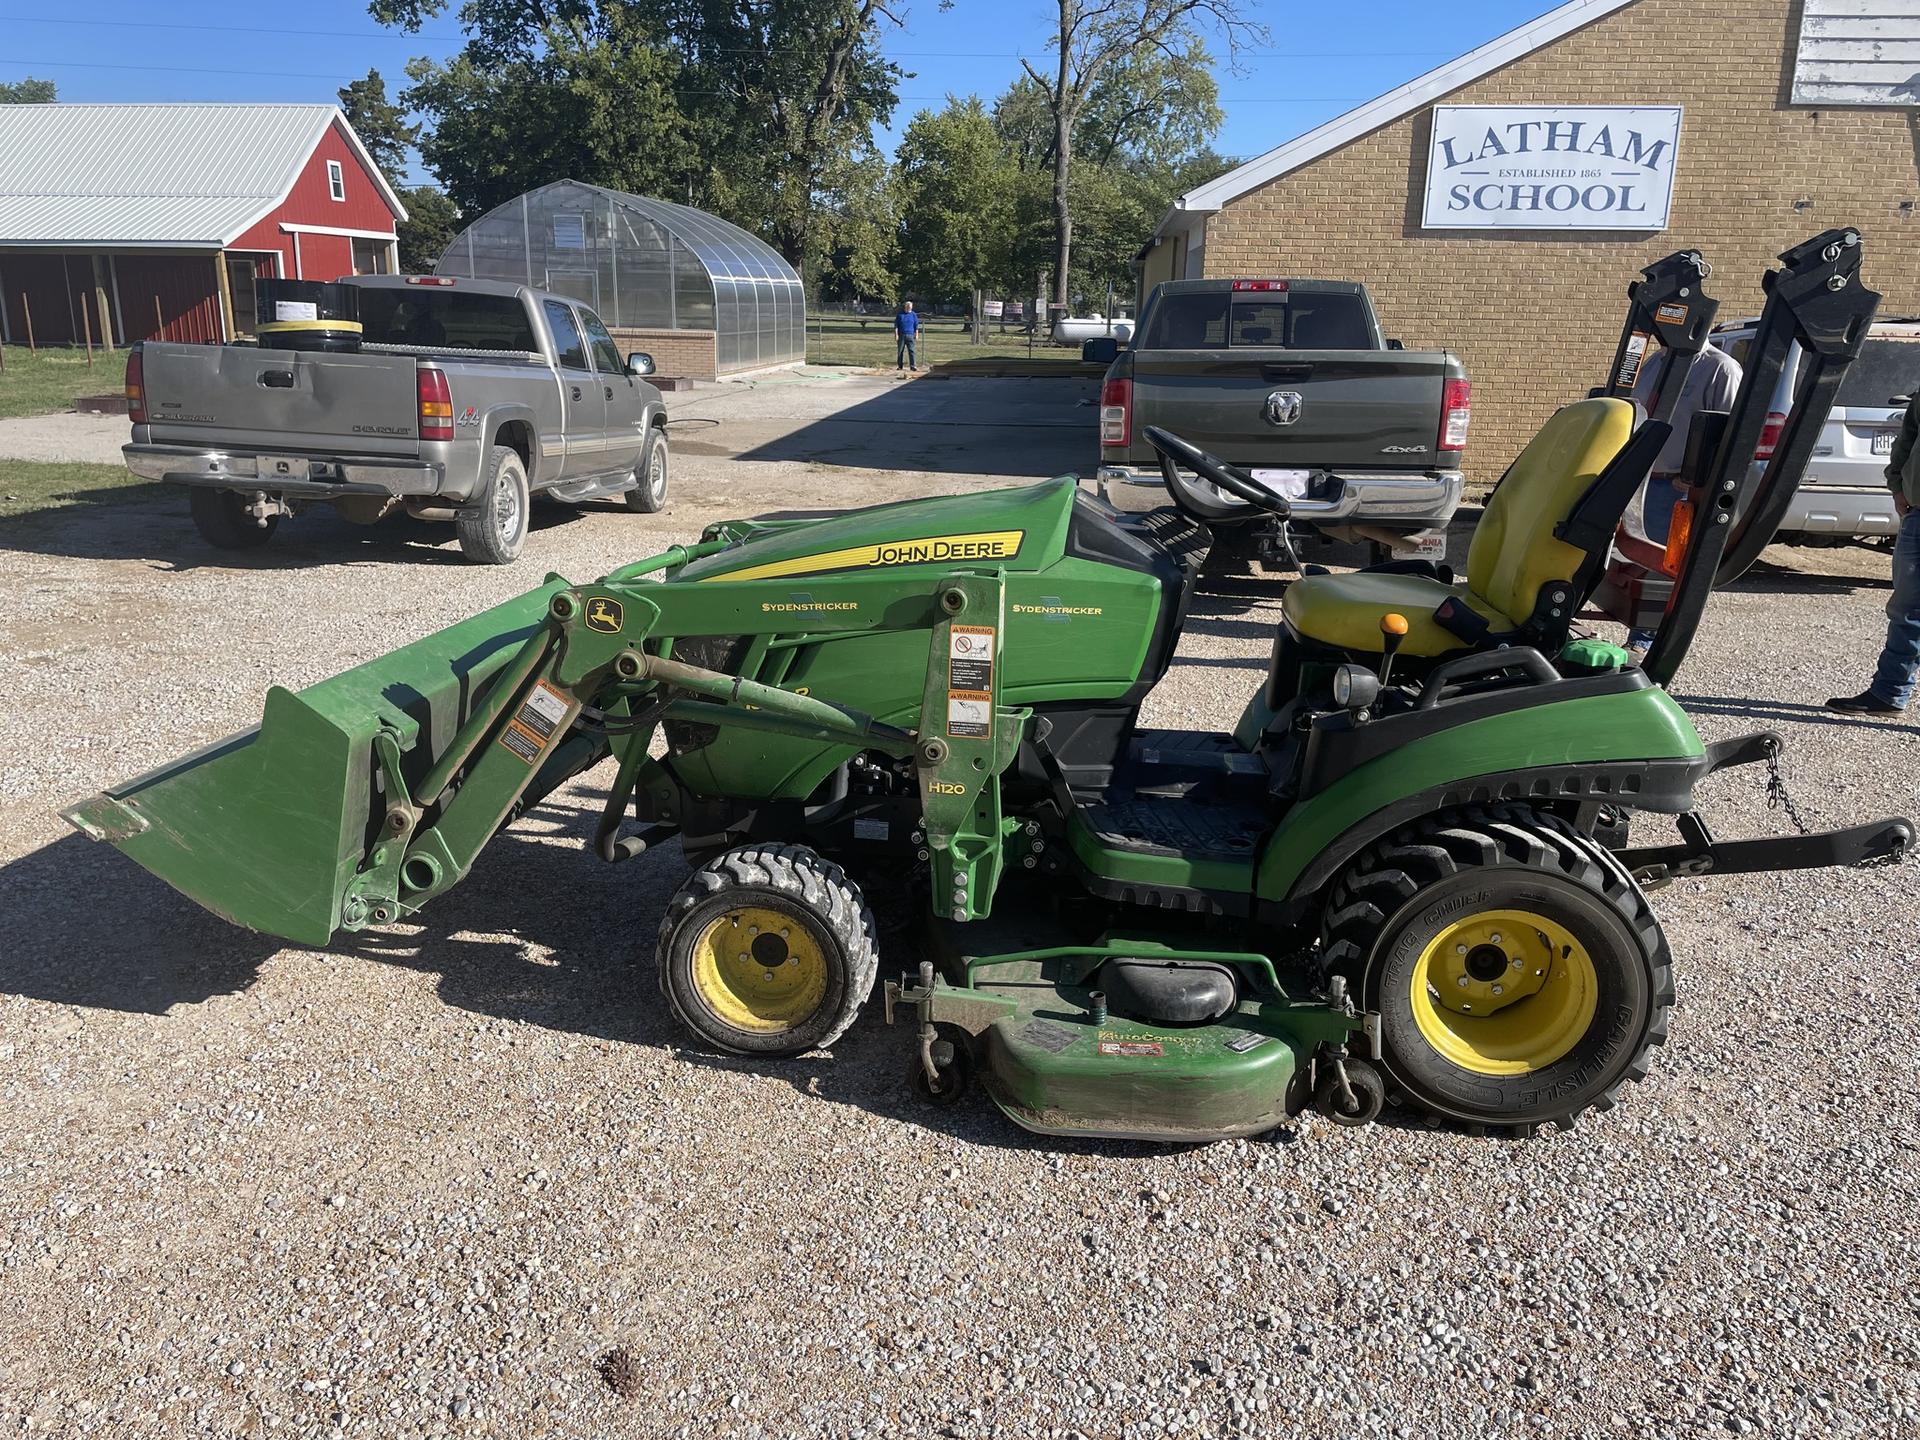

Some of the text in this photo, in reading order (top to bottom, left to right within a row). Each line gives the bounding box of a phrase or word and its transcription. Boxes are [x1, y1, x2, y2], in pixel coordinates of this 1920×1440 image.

[1438, 120, 1671, 172] LATHAM
[1499, 169, 1602, 178] ESTABLISHED 1865
[1447, 184, 1646, 212] SCHOOL
[1875, 435, 1896, 449] RH
[869, 542, 1004, 564] JOHN DEERE
[762, 603, 858, 611] SYDENSTRICKER
[1012, 604, 1103, 614] SYDENSTRICKER
[959, 627, 993, 635] WARNING
[928, 782, 966, 795] H120
[1384, 931, 1420, 988] TRAC
[1519, 1003, 1633, 1109] CARLISLE
